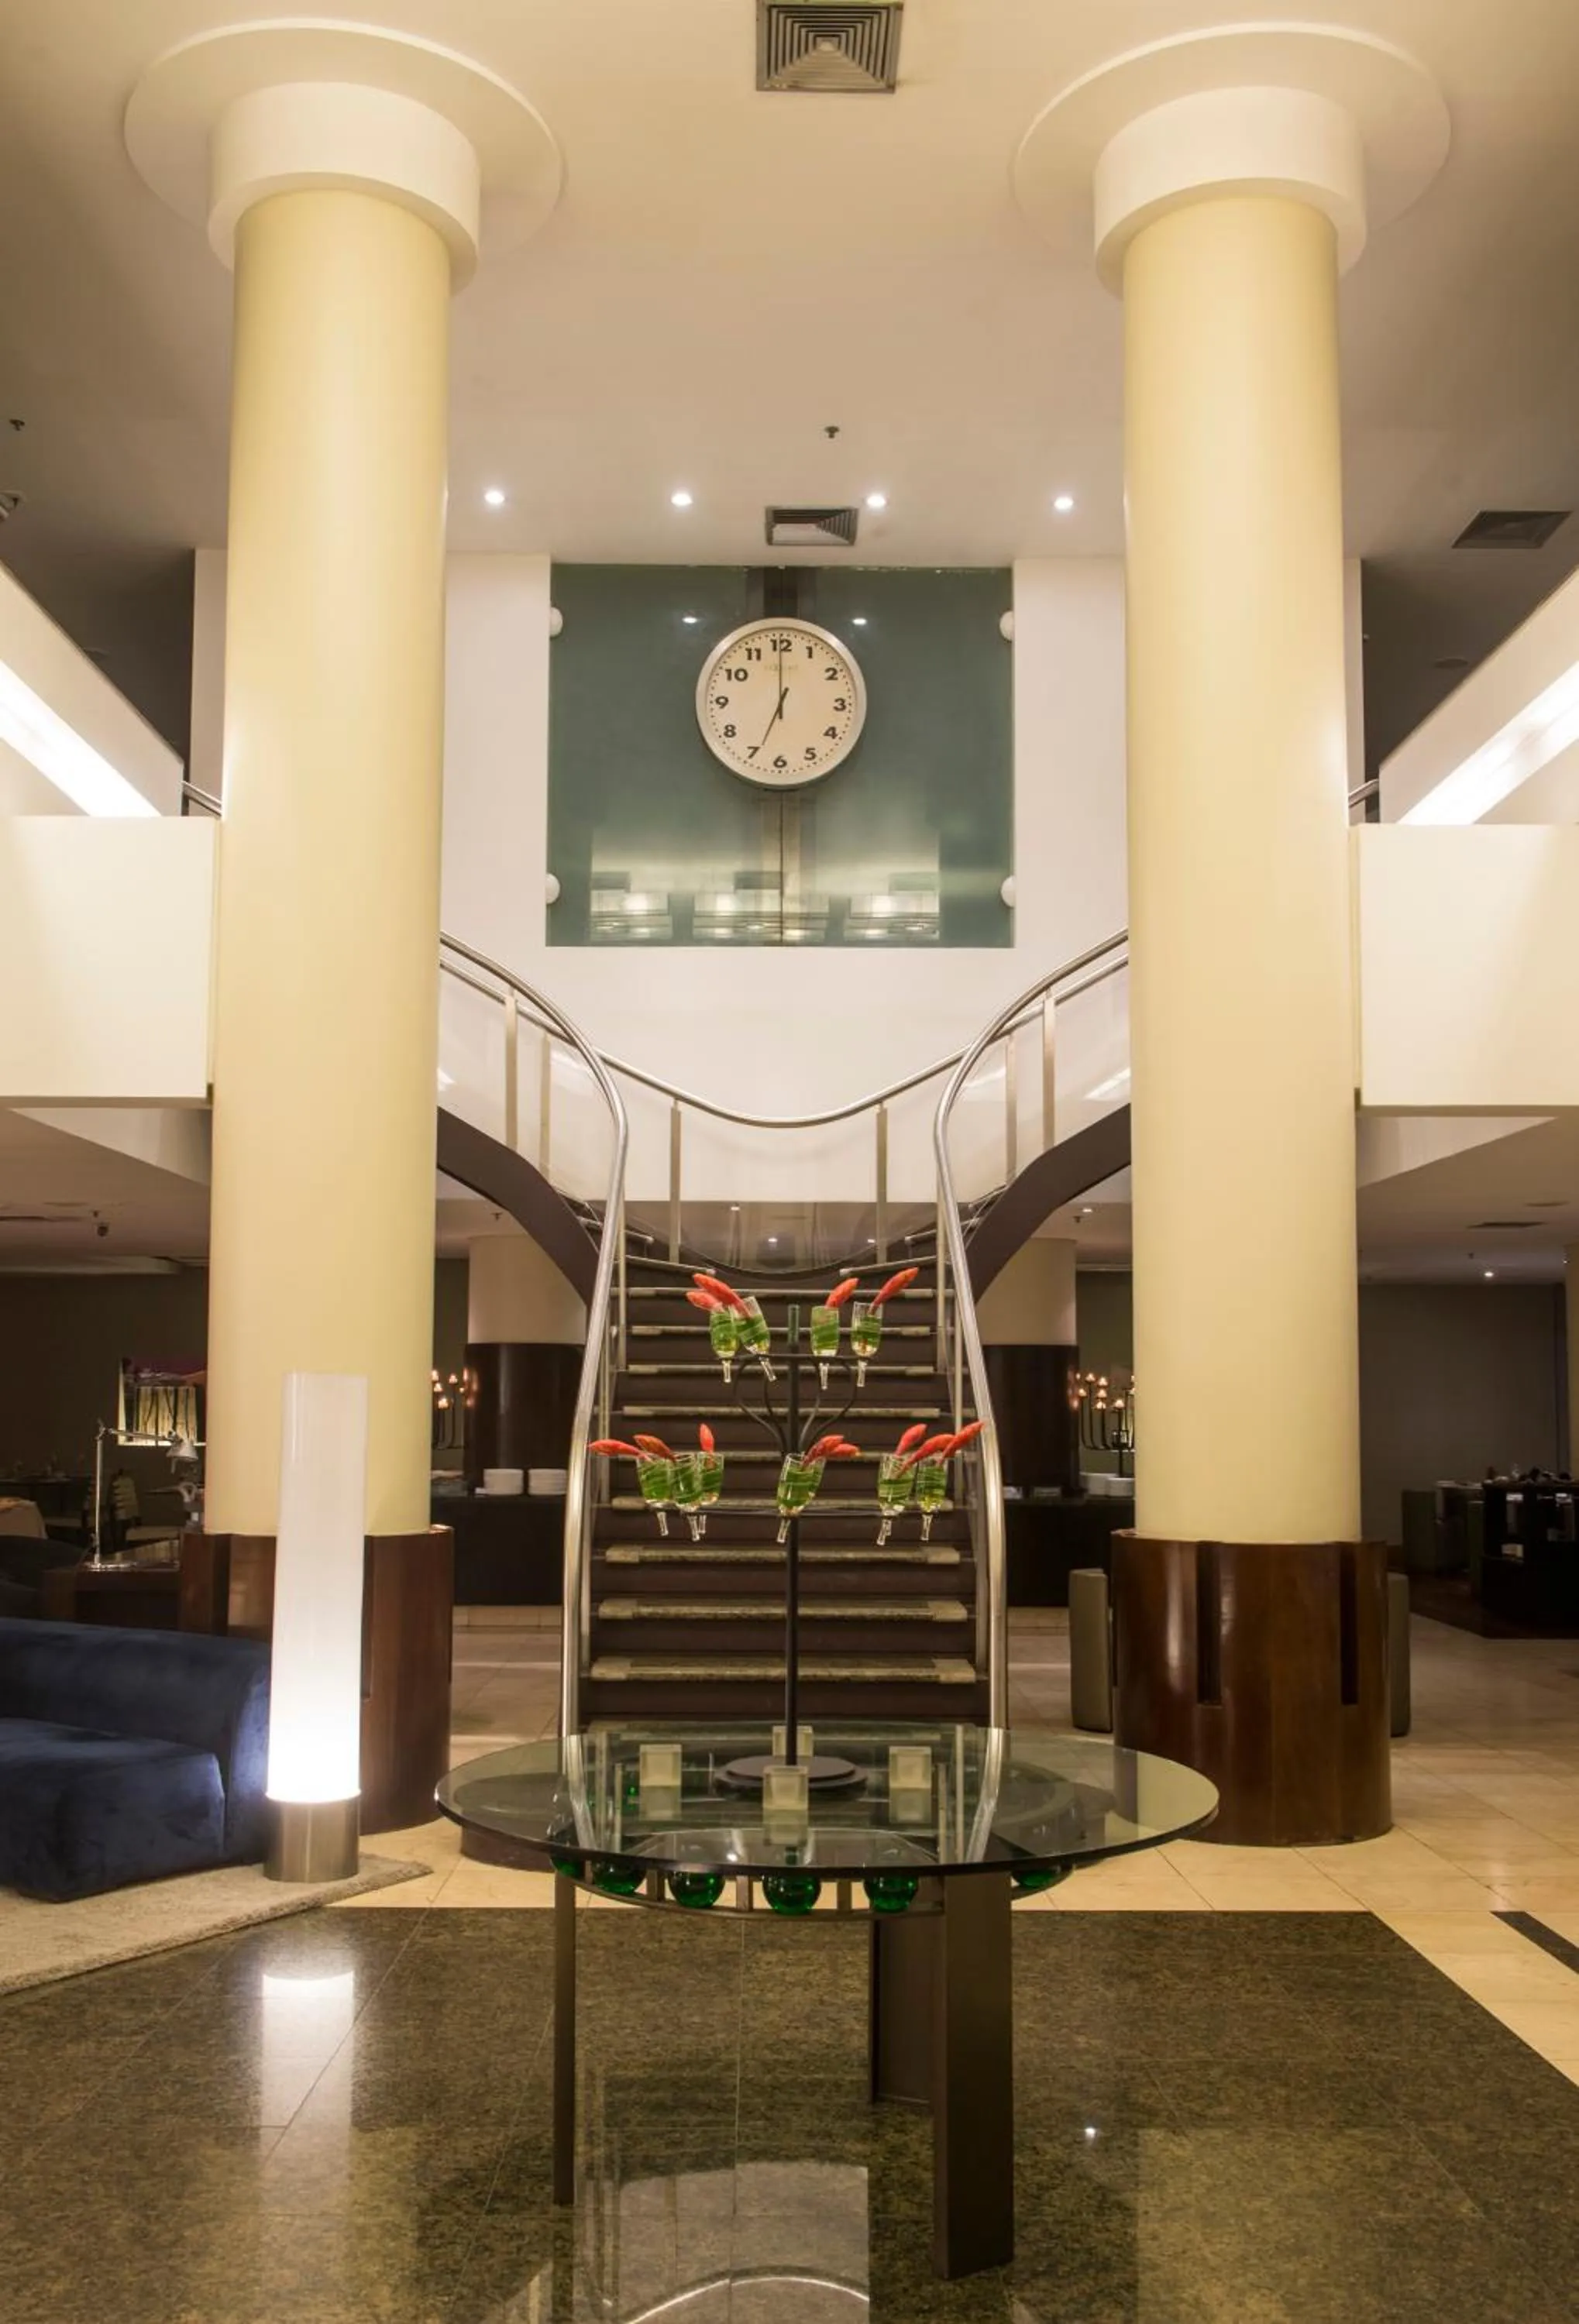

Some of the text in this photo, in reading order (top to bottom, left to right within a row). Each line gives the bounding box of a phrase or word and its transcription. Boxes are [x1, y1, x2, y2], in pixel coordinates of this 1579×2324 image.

[770, 639, 792, 652] 12
[806, 646, 813, 658] 1
[745, 648, 761, 661] 11
[725, 669, 748, 682] 10
[825, 668, 838, 680] 2
[715, 696, 729, 709] 9
[834, 698, 846, 711] 3
[724, 724, 736, 737] 8
[823, 727, 838, 739] 4
[747, 746, 760, 759] 7
[804, 748, 817, 761] 5
[773, 756, 787, 768] 6
